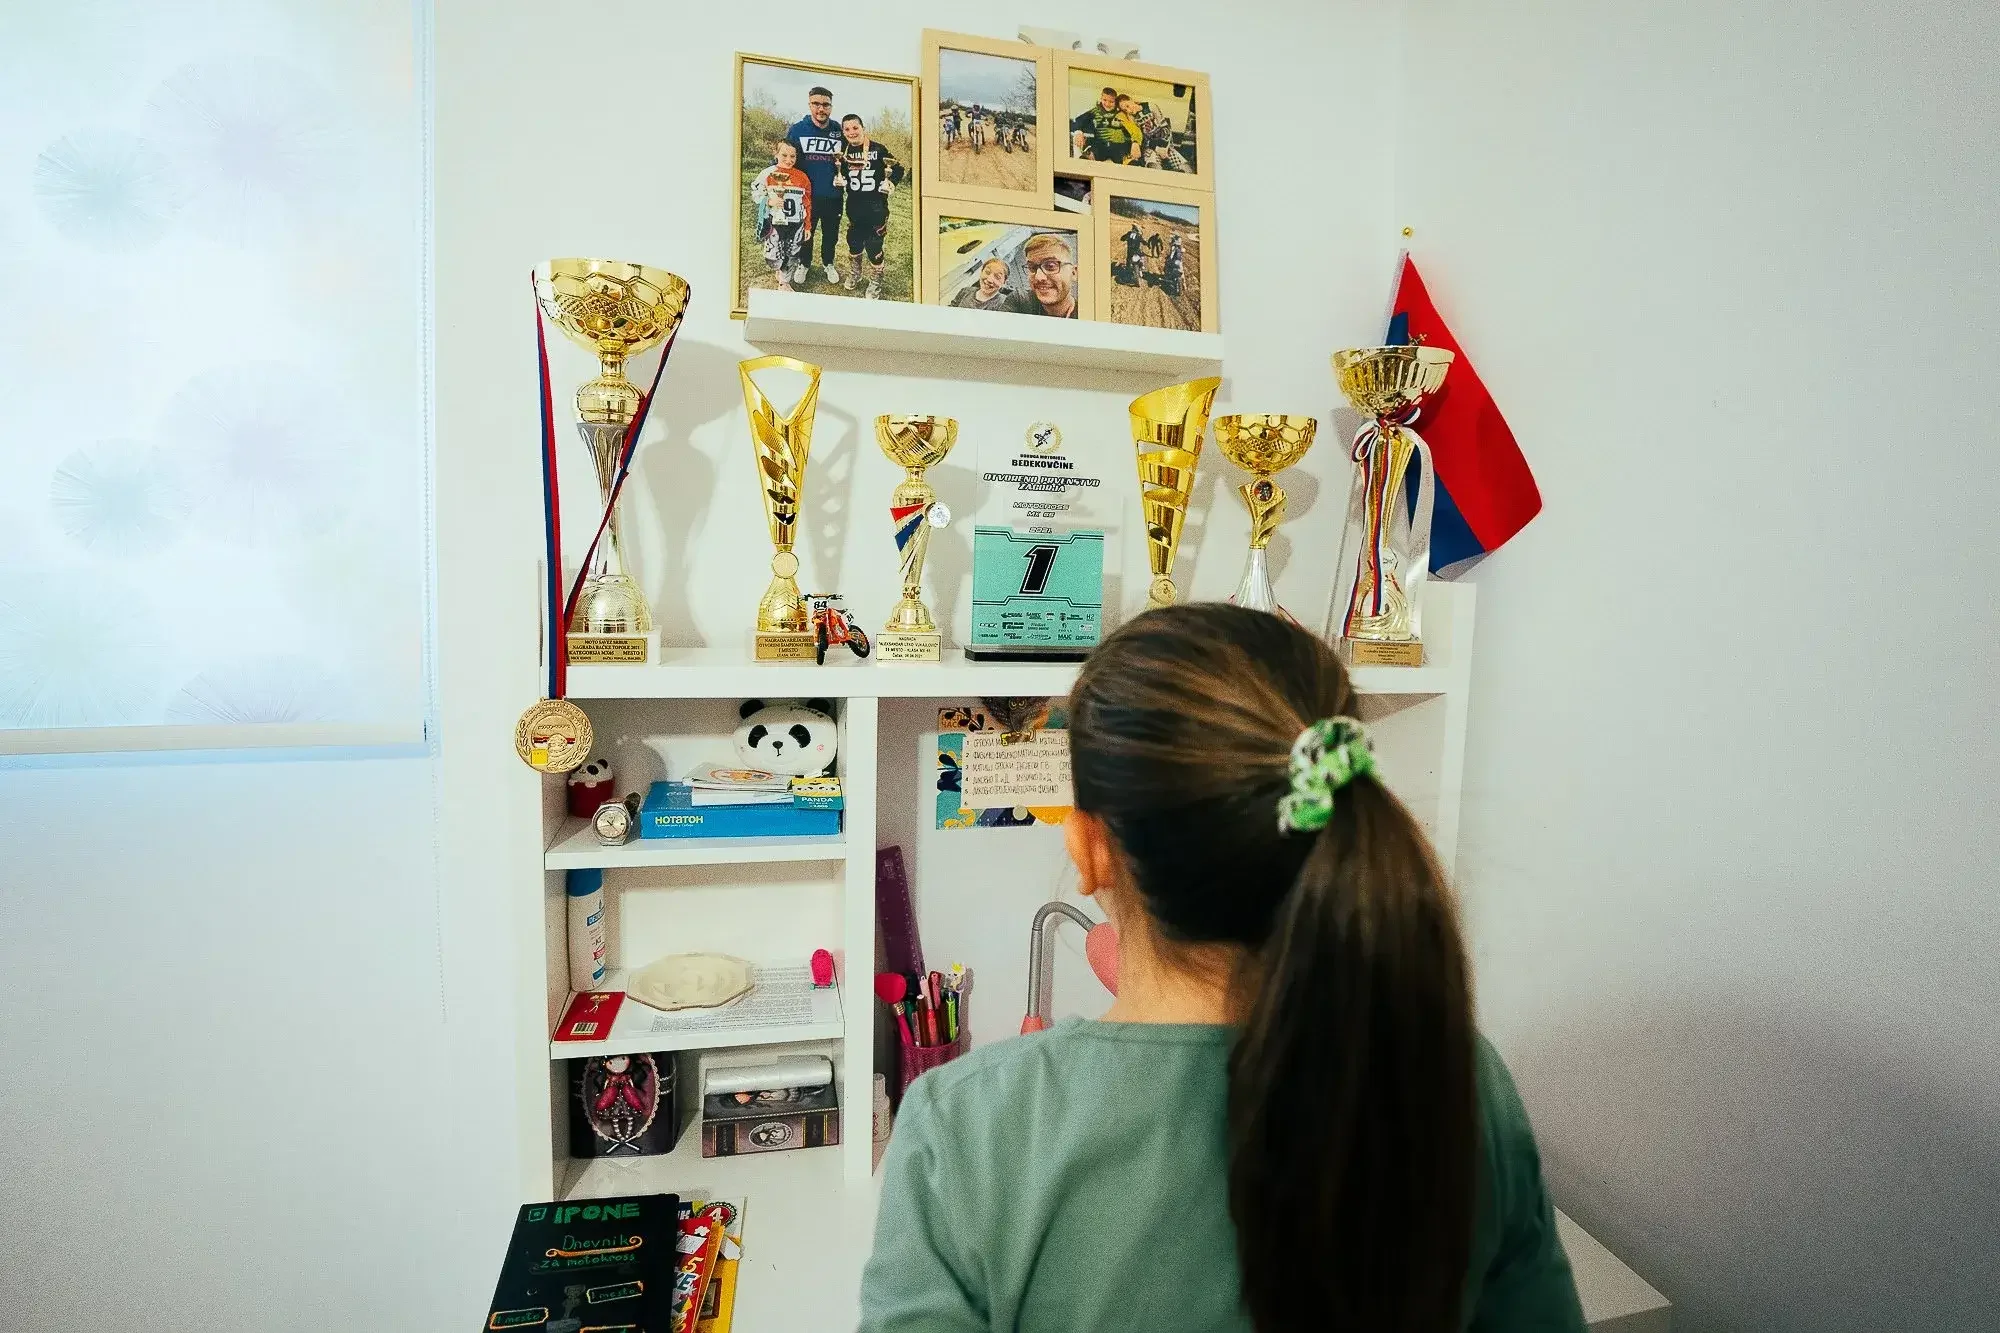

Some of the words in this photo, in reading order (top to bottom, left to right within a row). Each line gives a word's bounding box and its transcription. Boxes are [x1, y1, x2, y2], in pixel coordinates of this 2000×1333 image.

[806, 138, 837, 152] FOX
[848, 170, 876, 191] 65
[1012, 460, 1074, 469] BEDEKOVČINE
[983, 473, 1038, 483] OTVORENO
[1039, 476, 1100, 487] PRVENSTVO
[1018, 483, 1066, 492] ZAGORJA
[1019, 544, 1060, 595] 1
[814, 600, 828, 610] 84
[553, 1203, 640, 1224] IPONE
[562, 1234, 629, 1250] Dnevnik
[540, 1259, 560, 1268] za
[567, 1253, 635, 1267] motokross
[600, 1288, 636, 1299] mesto
[505, 1312, 540, 1322] mesto
